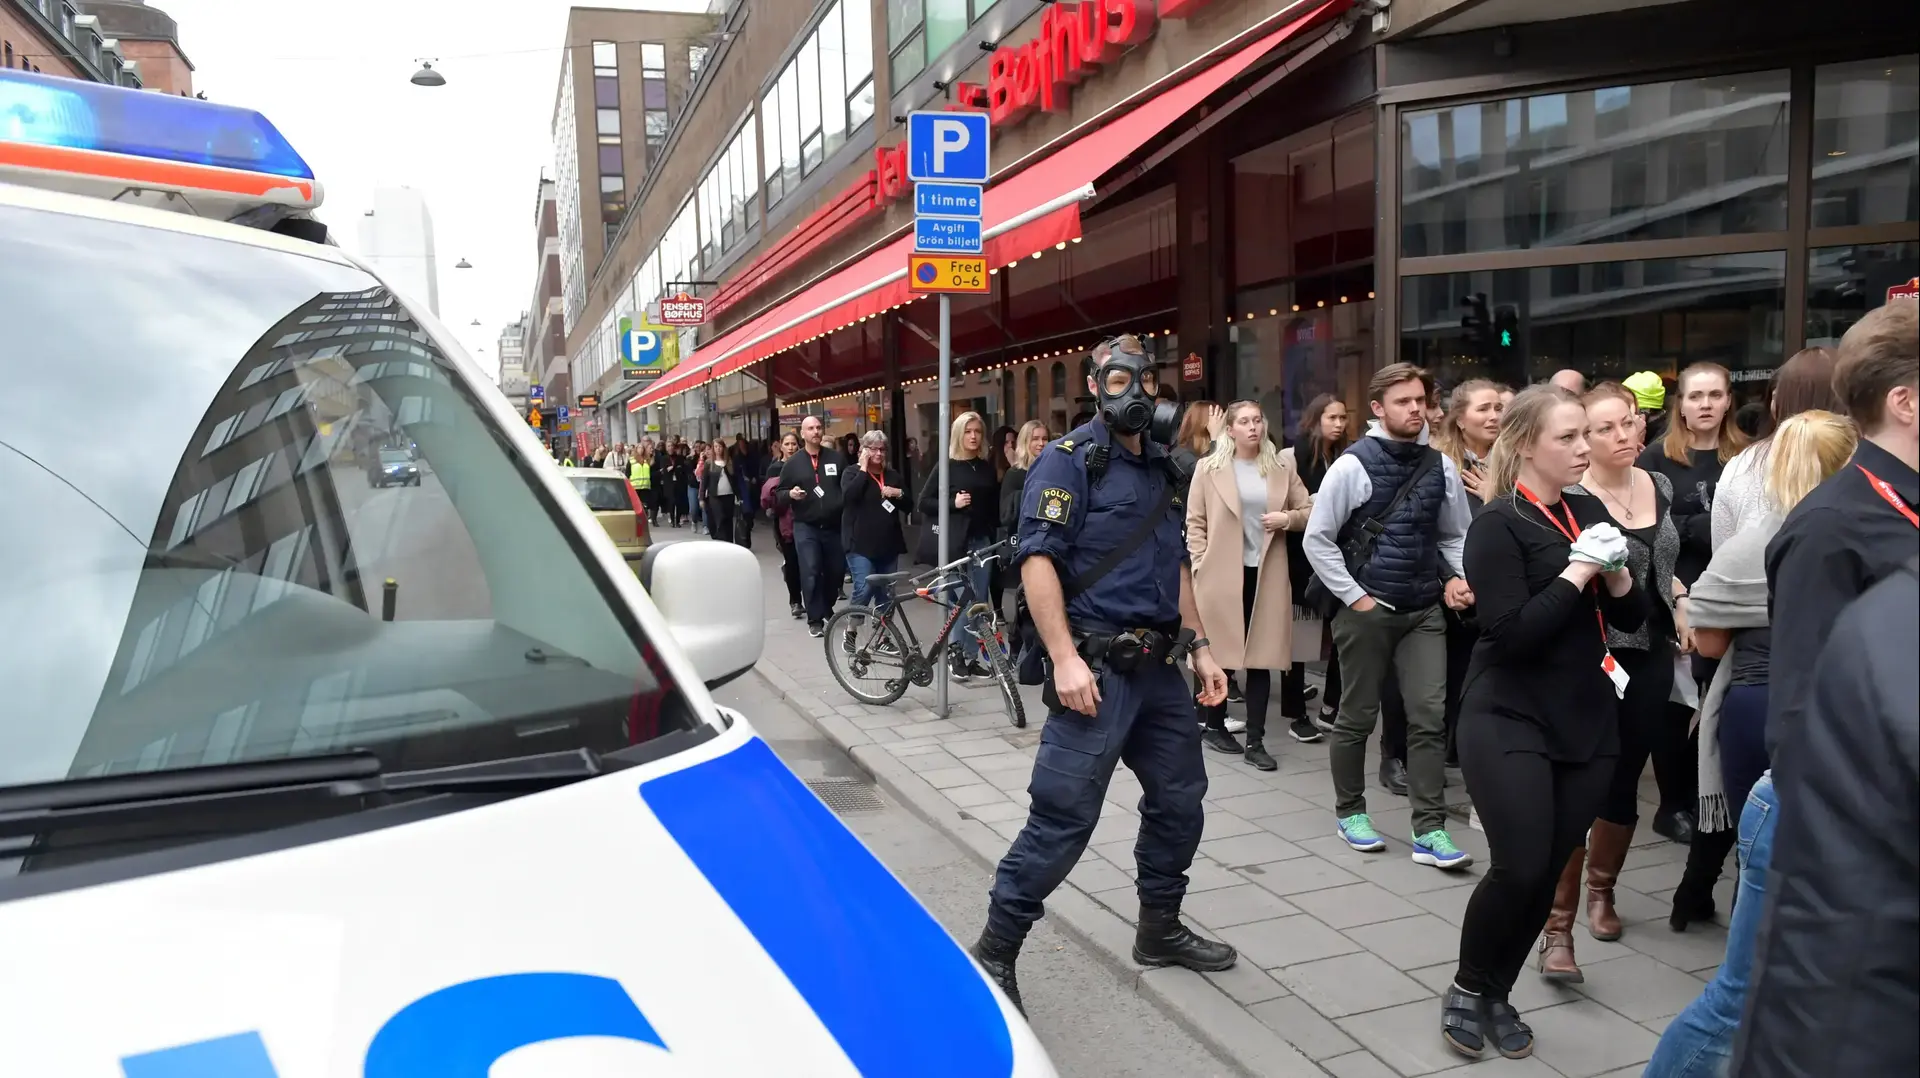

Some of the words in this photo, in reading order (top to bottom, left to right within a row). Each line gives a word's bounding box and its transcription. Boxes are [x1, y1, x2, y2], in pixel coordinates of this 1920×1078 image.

[933, 119, 971, 173] P
[920, 193, 926, 205] 1
[931, 193, 978, 208] timme
[932, 223, 965, 234] Avgift
[918, 234, 944, 246] Grön
[947, 235, 979, 248] biljett
[950, 261, 981, 273] Fred
[662, 302, 704, 311] JENSEN'S
[664, 310, 703, 319] BØFHUS
[630, 330, 656, 362] P
[559, 407, 567, 417] P
[1044, 489, 1070, 502] POLIS
